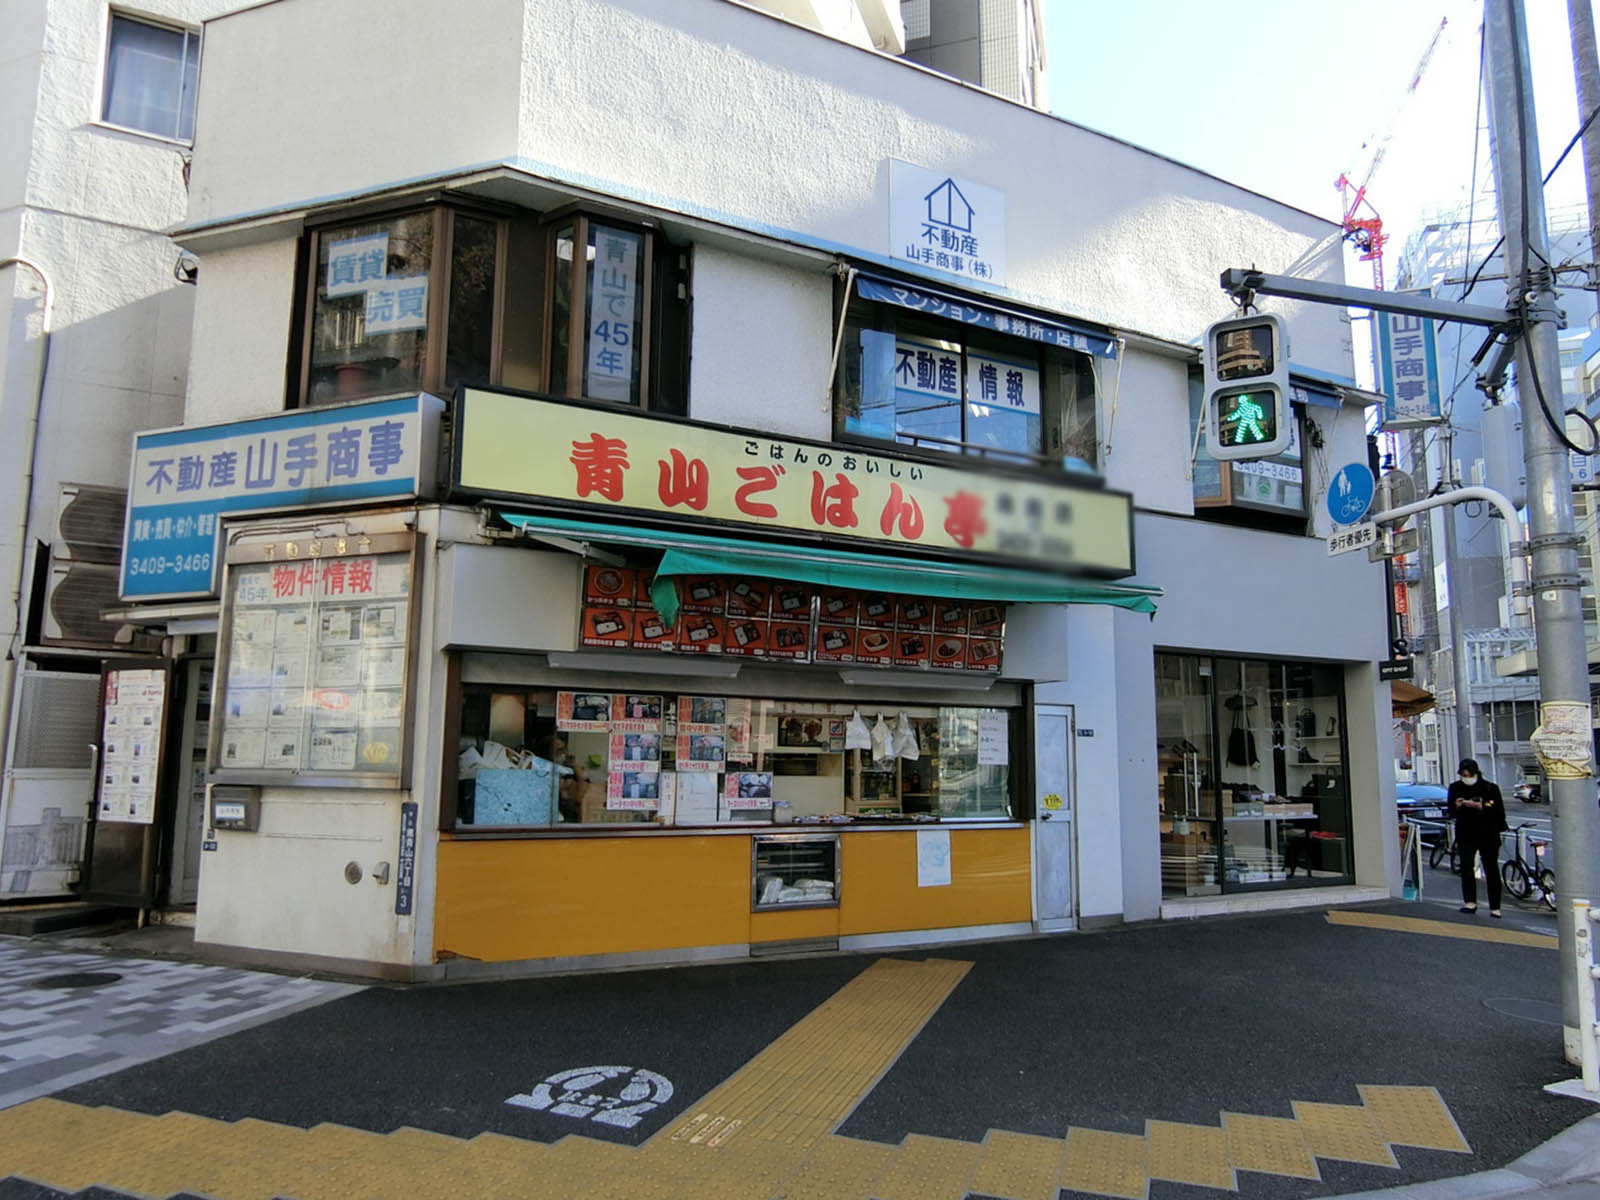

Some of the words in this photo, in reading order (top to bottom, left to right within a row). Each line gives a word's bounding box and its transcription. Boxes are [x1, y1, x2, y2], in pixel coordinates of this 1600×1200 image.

[921, 223, 979, 258] 不動産
[331, 248, 384, 287] 賃貸
[367, 282, 426, 325] 売買
[1392, 314, 1426, 401] 山手商事
[896, 349, 957, 394] 不動産
[979, 362, 1025, 407] 情報
[743, 440, 924, 482] ごはんのおいしい
[1330, 528, 1372, 552] 歩行者優先
[129, 553, 210, 576] 3409-3466
[273, 560, 373, 599] 物件情報
